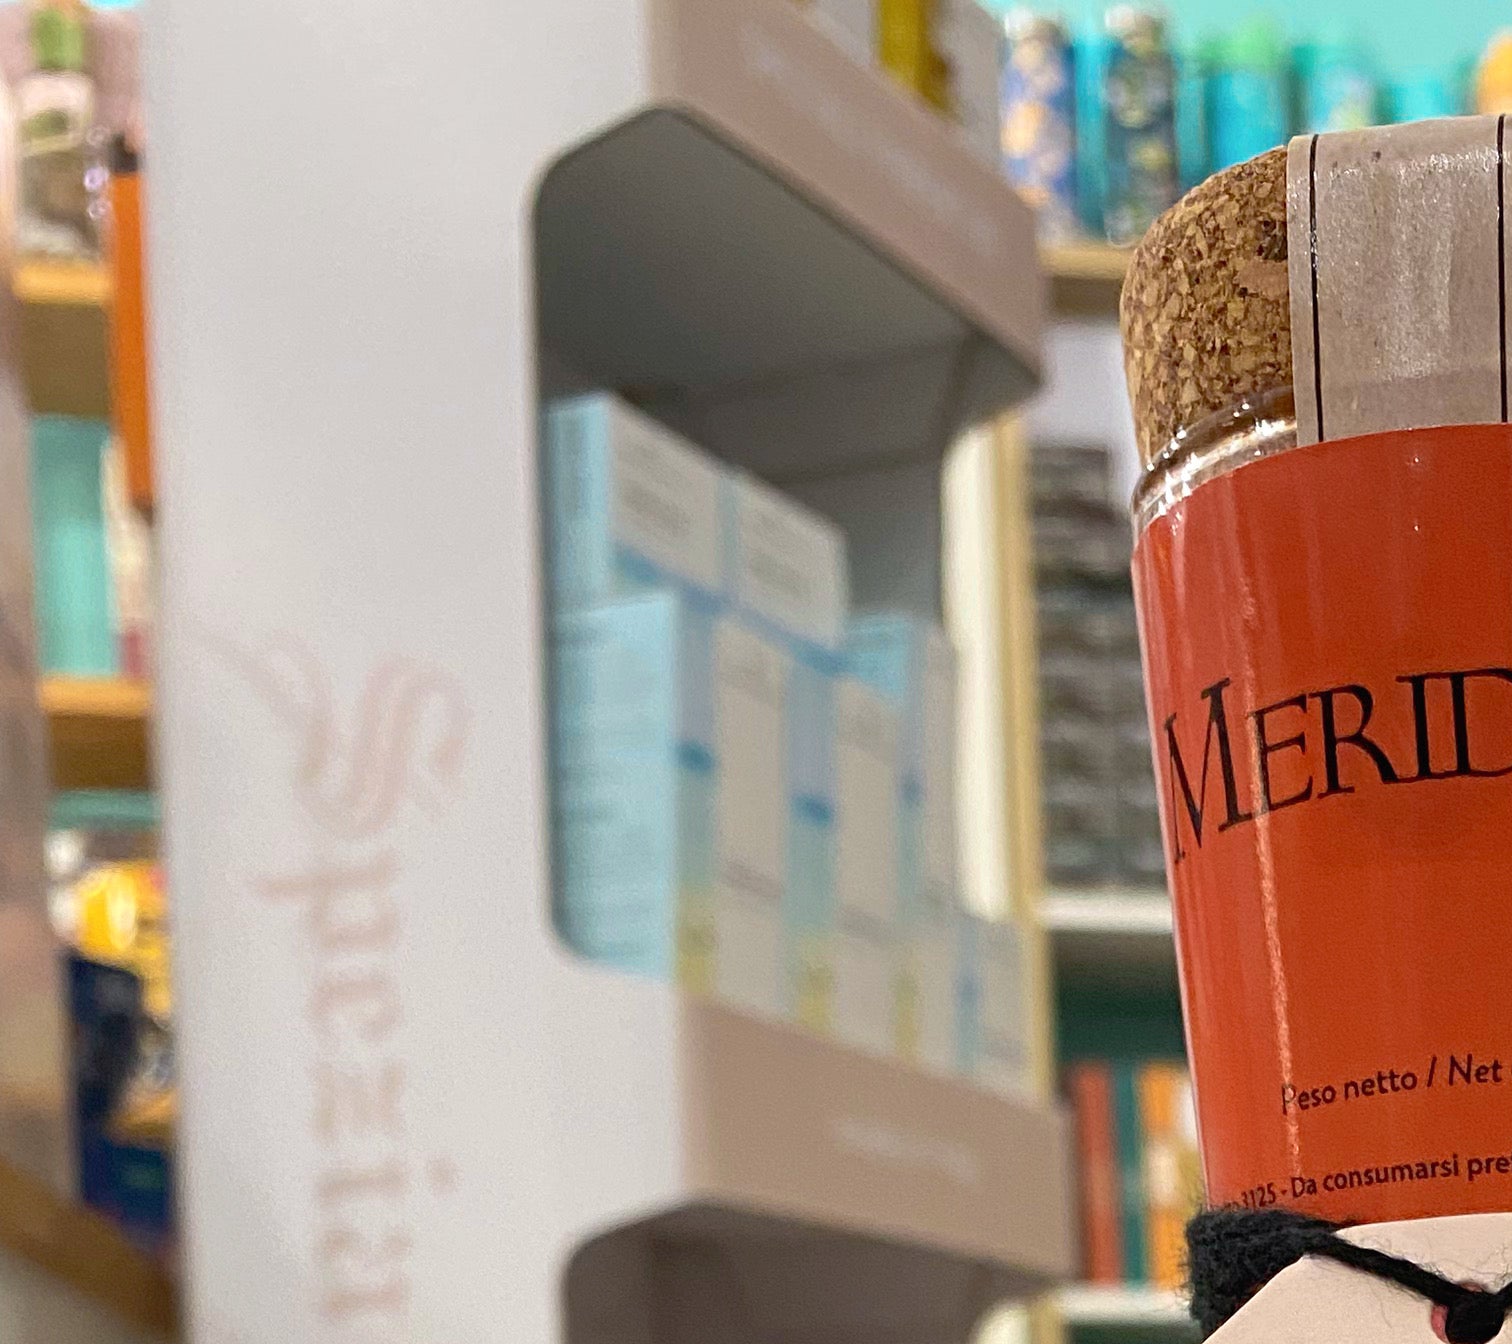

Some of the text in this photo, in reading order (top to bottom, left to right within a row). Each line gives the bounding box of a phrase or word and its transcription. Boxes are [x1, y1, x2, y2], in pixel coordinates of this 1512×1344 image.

[1281, 1084, 1337, 1116] Peso
[1343, 1069, 1418, 1101] netto
[1448, 1053, 1503, 1087] Net
[1290, 1176, 1318, 1199] Da
[1322, 1153, 1460, 1193] consumarsi
